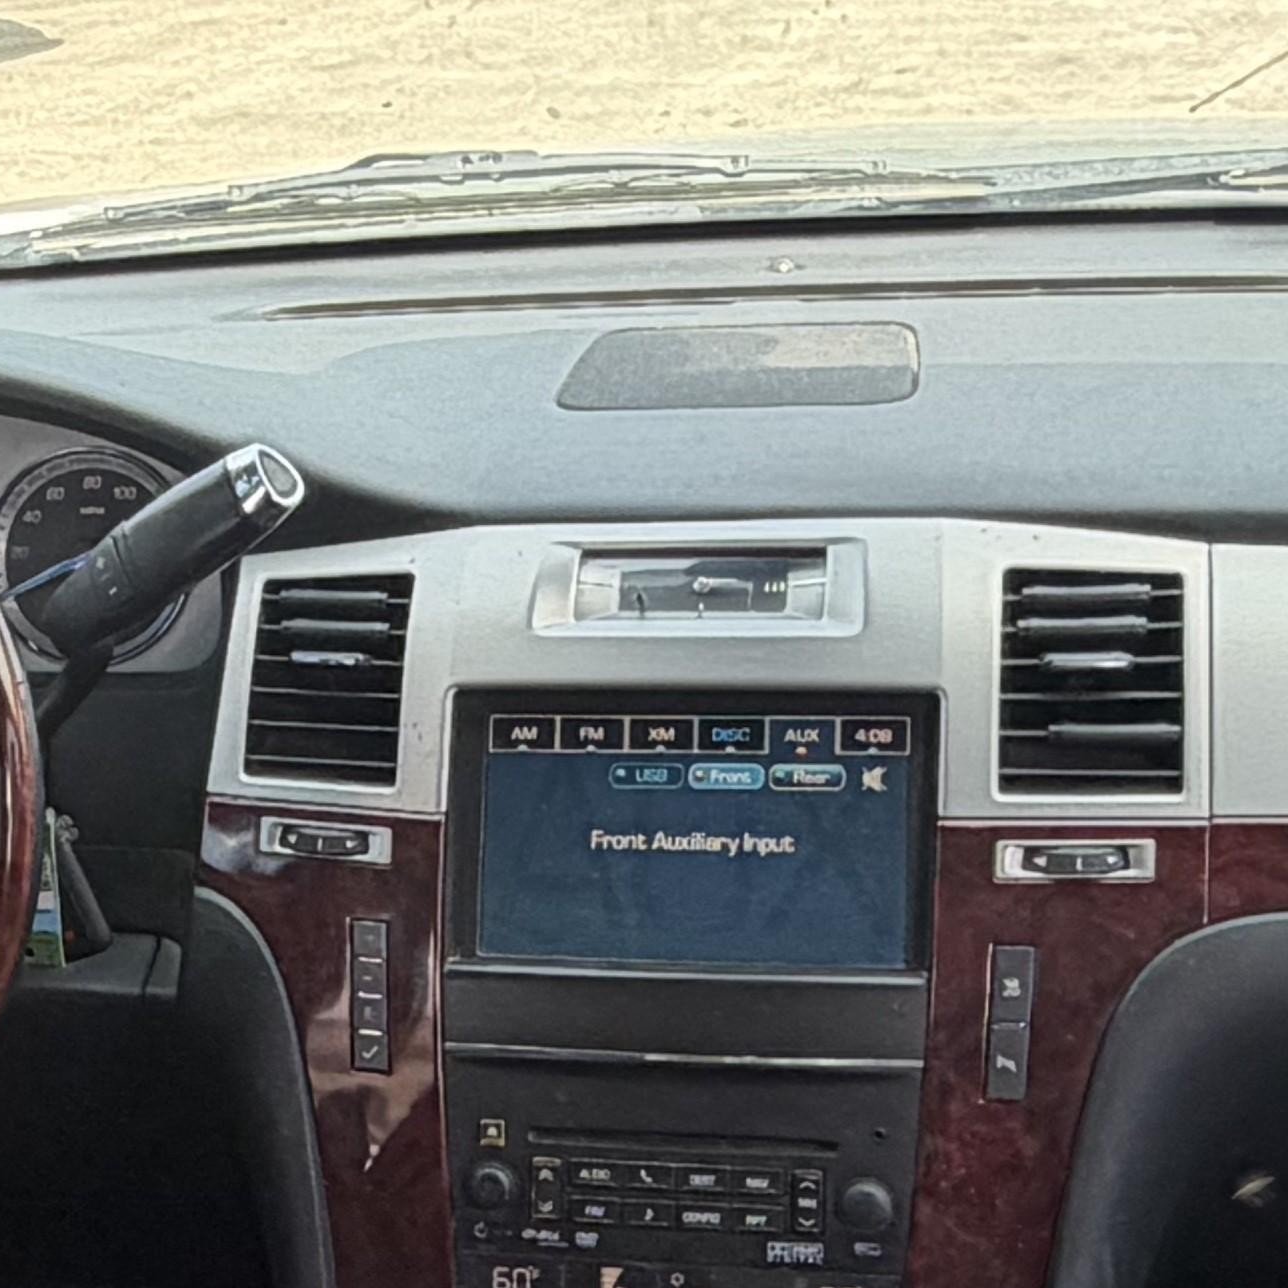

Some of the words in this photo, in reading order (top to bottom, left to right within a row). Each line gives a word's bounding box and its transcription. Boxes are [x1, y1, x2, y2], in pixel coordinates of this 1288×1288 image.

[113, 486, 137, 500] 100
[22, 510, 42, 524] 40
[510, 726, 538, 741] AM
[579, 727, 604, 741] FM
[647, 727, 676, 742] XM
[712, 727, 751, 742] DISC
[783, 728, 820, 743] AUX
[635, 769, 668, 783] USB
[709, 769, 752, 784] Front
[793, 770, 831, 784] Rear
[590, 830, 647, 850] Front
[652, 831, 739, 857] Auxiliary
[743, 832, 796, 856] Input
